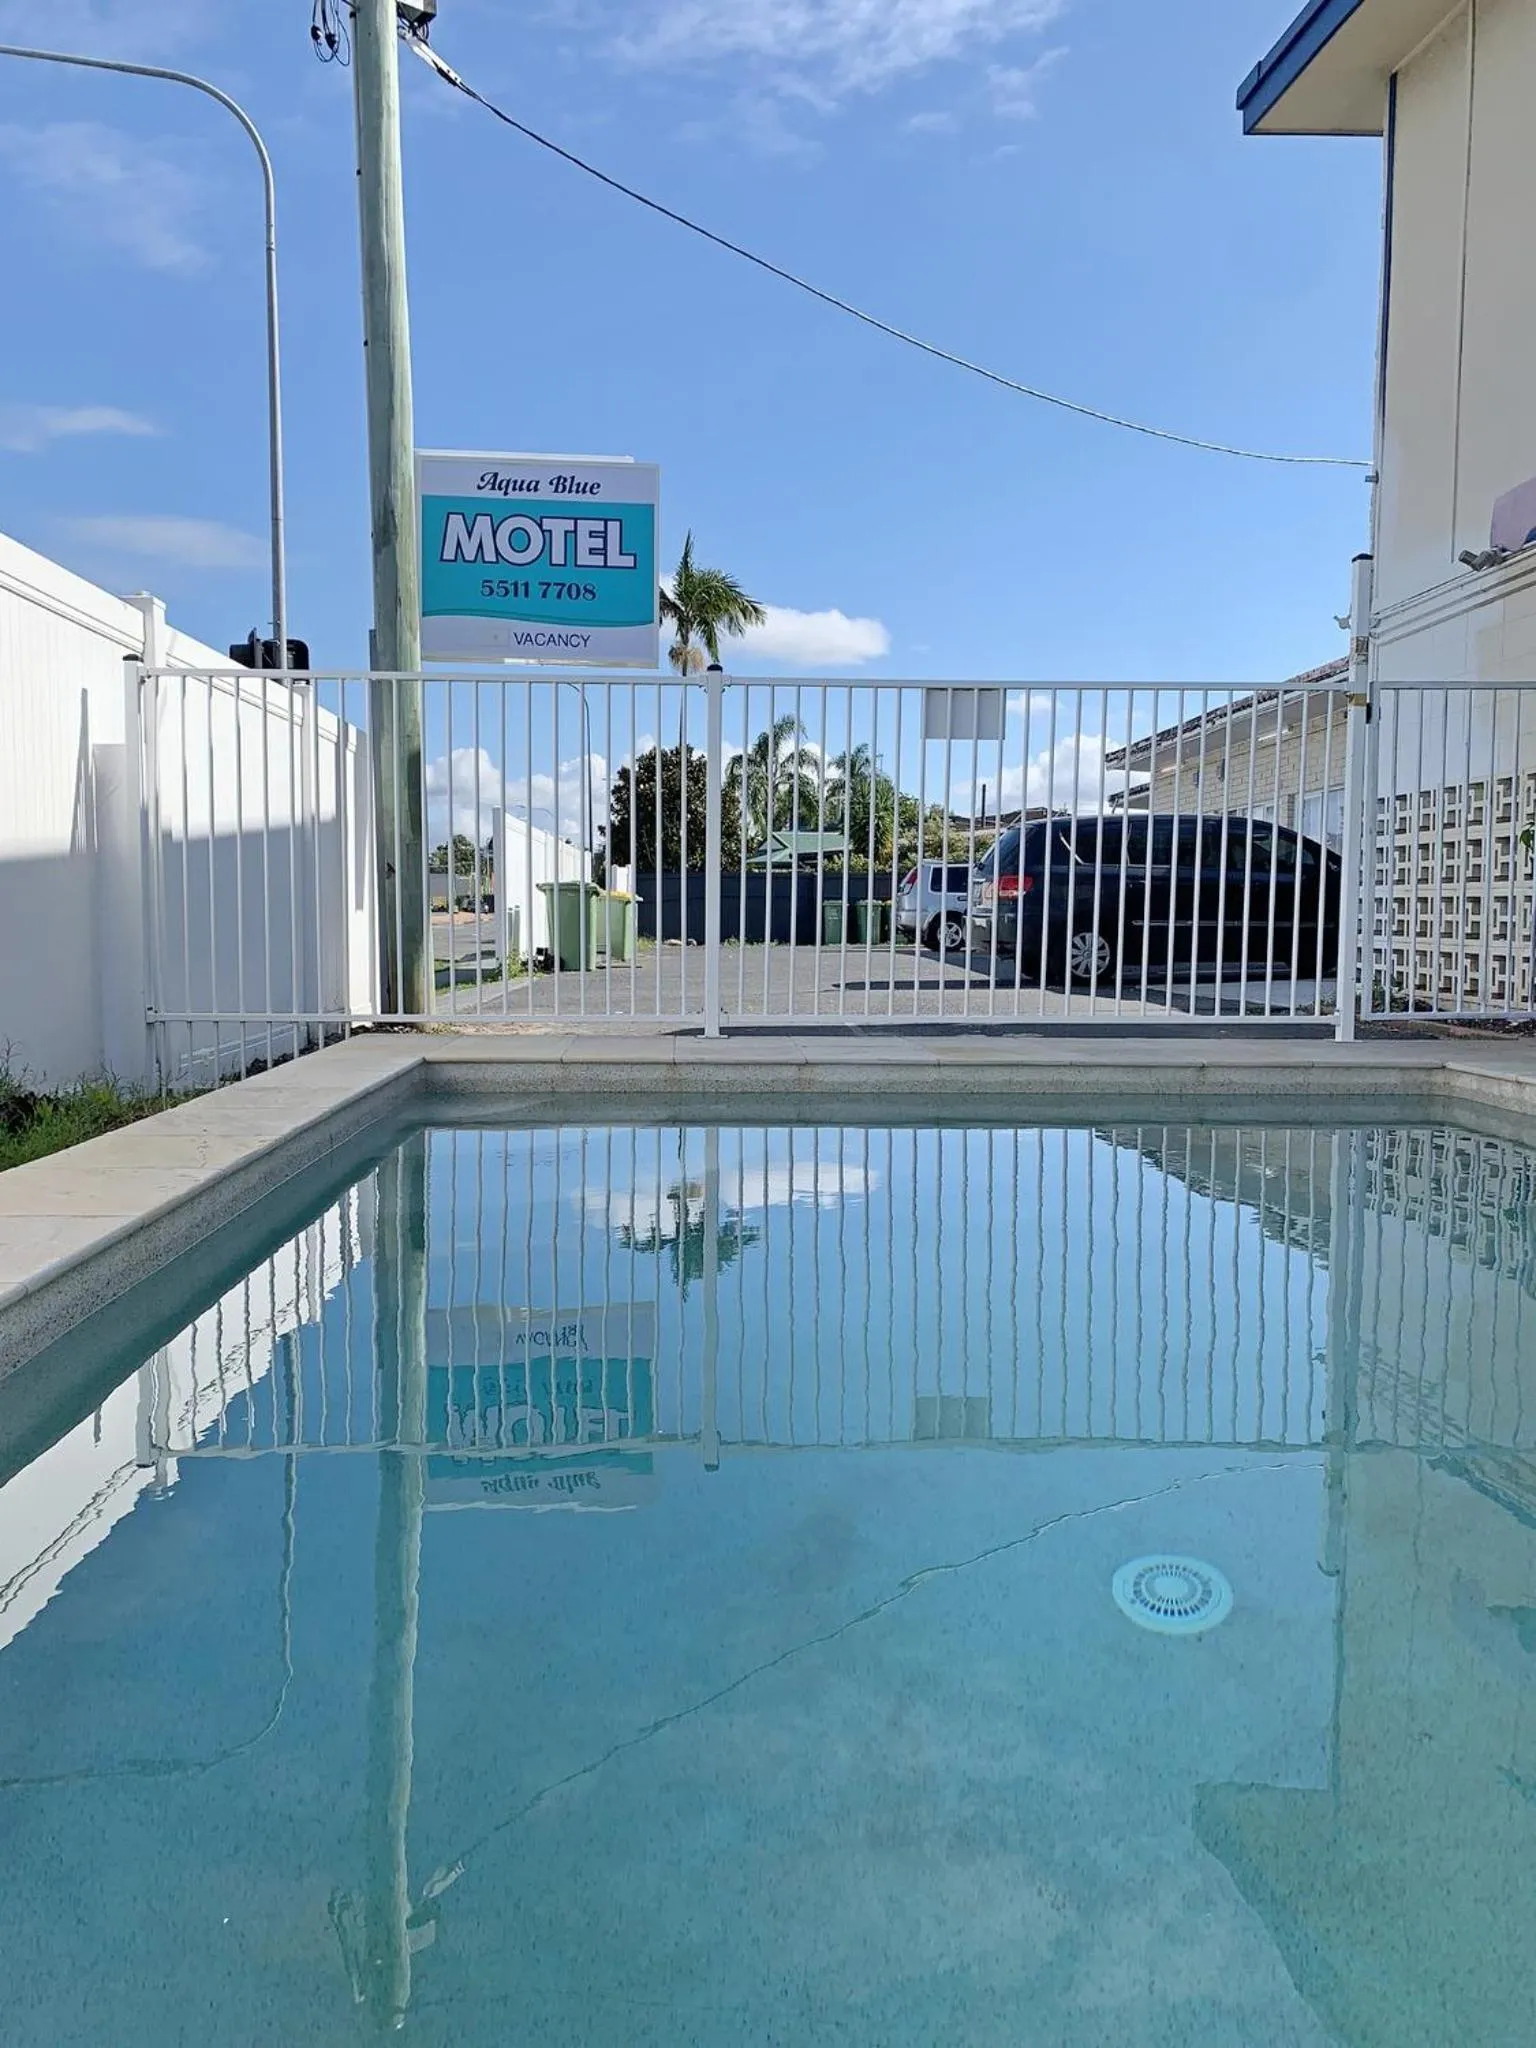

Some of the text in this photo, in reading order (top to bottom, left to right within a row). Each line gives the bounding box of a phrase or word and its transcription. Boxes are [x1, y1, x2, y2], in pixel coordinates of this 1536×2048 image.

[477, 472, 601, 496] Aqua Blue
[440, 512, 637, 569] MOTEL
[480, 579, 597, 600] 5511 7708
[513, 632, 591, 648] VACANCY
